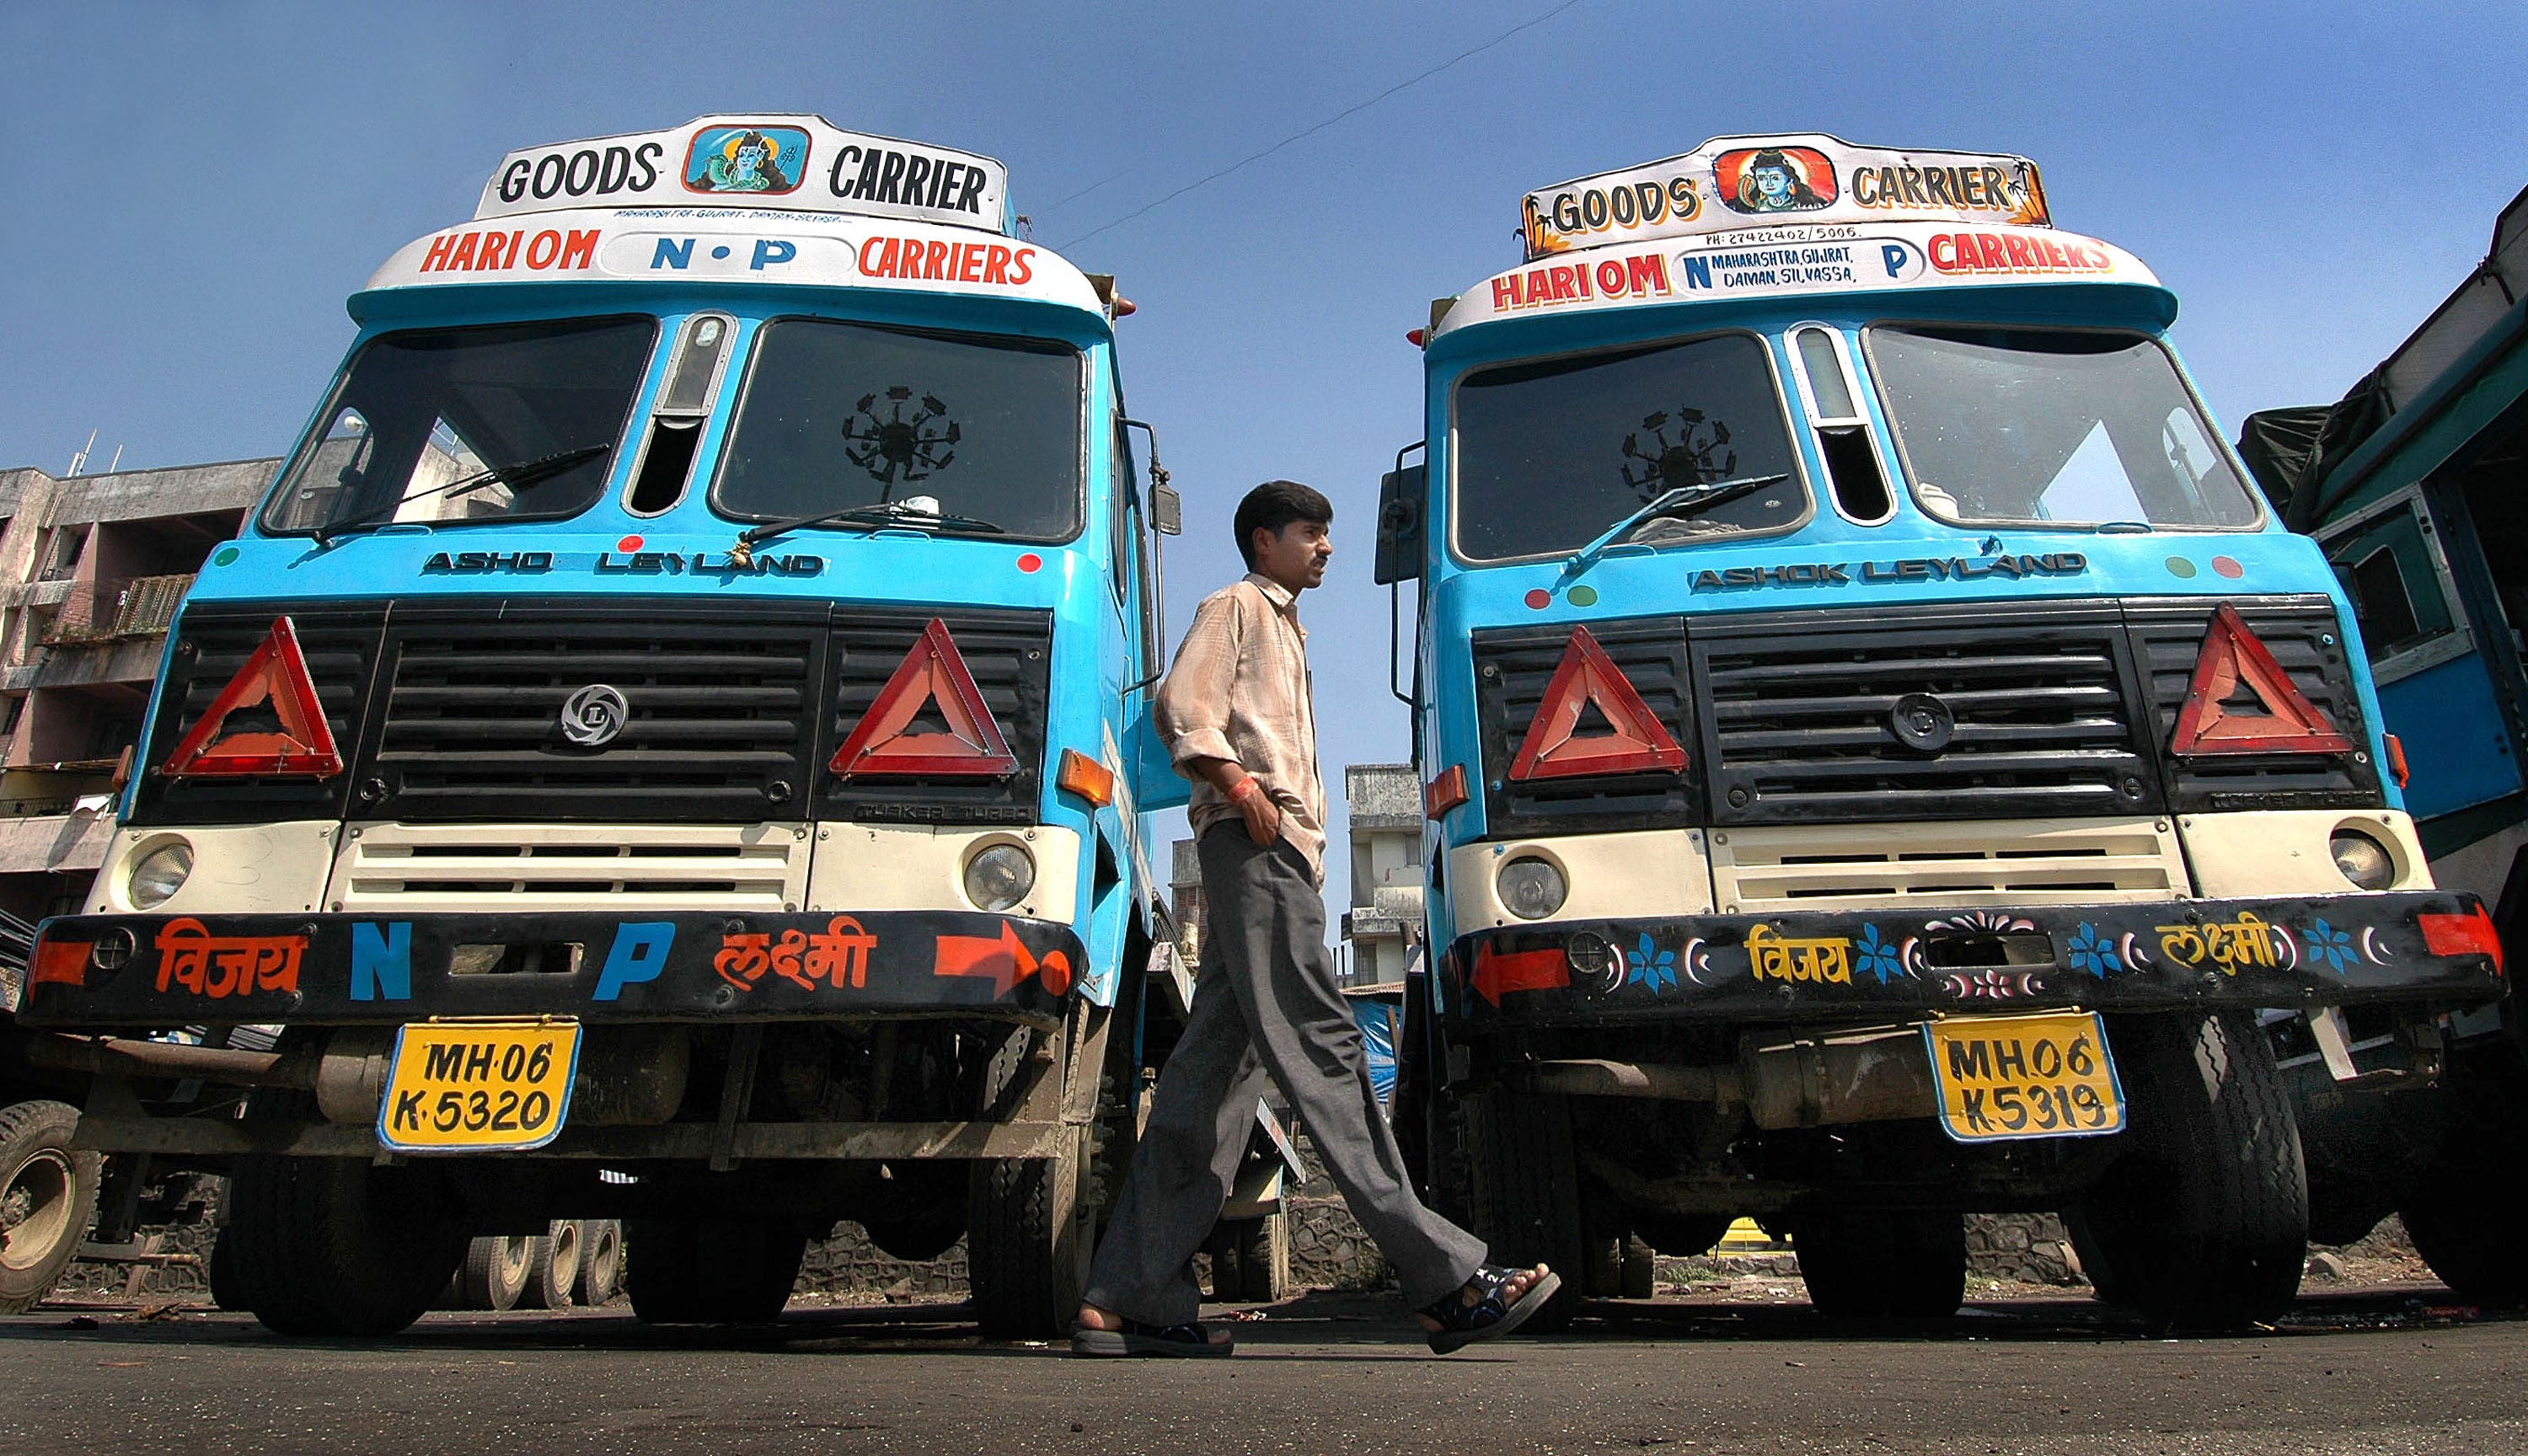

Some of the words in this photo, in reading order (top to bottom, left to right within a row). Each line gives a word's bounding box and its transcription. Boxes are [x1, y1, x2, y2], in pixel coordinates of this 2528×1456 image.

[499, 142, 664, 203] GOODS
[830, 145, 987, 215] CARRIER
[1552, 176, 1705, 236] GOODS
[1851, 165, 2016, 212] CARRIER
[420, 231, 524, 272] HARI
[526, 228, 603, 270] OM
[650, 238, 697, 270] N
[749, 238, 796, 270] P
[858, 236, 1036, 285] CARRIERS
[1706, 234, 1725, 245] PH:
[1881, 244, 1907, 278] P
[1927, 233, 2114, 276] CARRIERS
[1491, 262, 1596, 313] HARI
[1596, 254, 1673, 299] OM
[1684, 255, 1712, 289] N
[1693, 564, 1850, 588] ASHOK
[1863, 552, 2087, 578] LEYLAND
[155, 918, 308, 998] विजय
[351, 923, 411, 1000] N
[592, 922, 675, 1000] P
[714, 915, 877, 992] लक्ष्मी
[1743, 923, 1852, 986] विजय
[2154, 911, 2277, 977] लक्ष्मी
